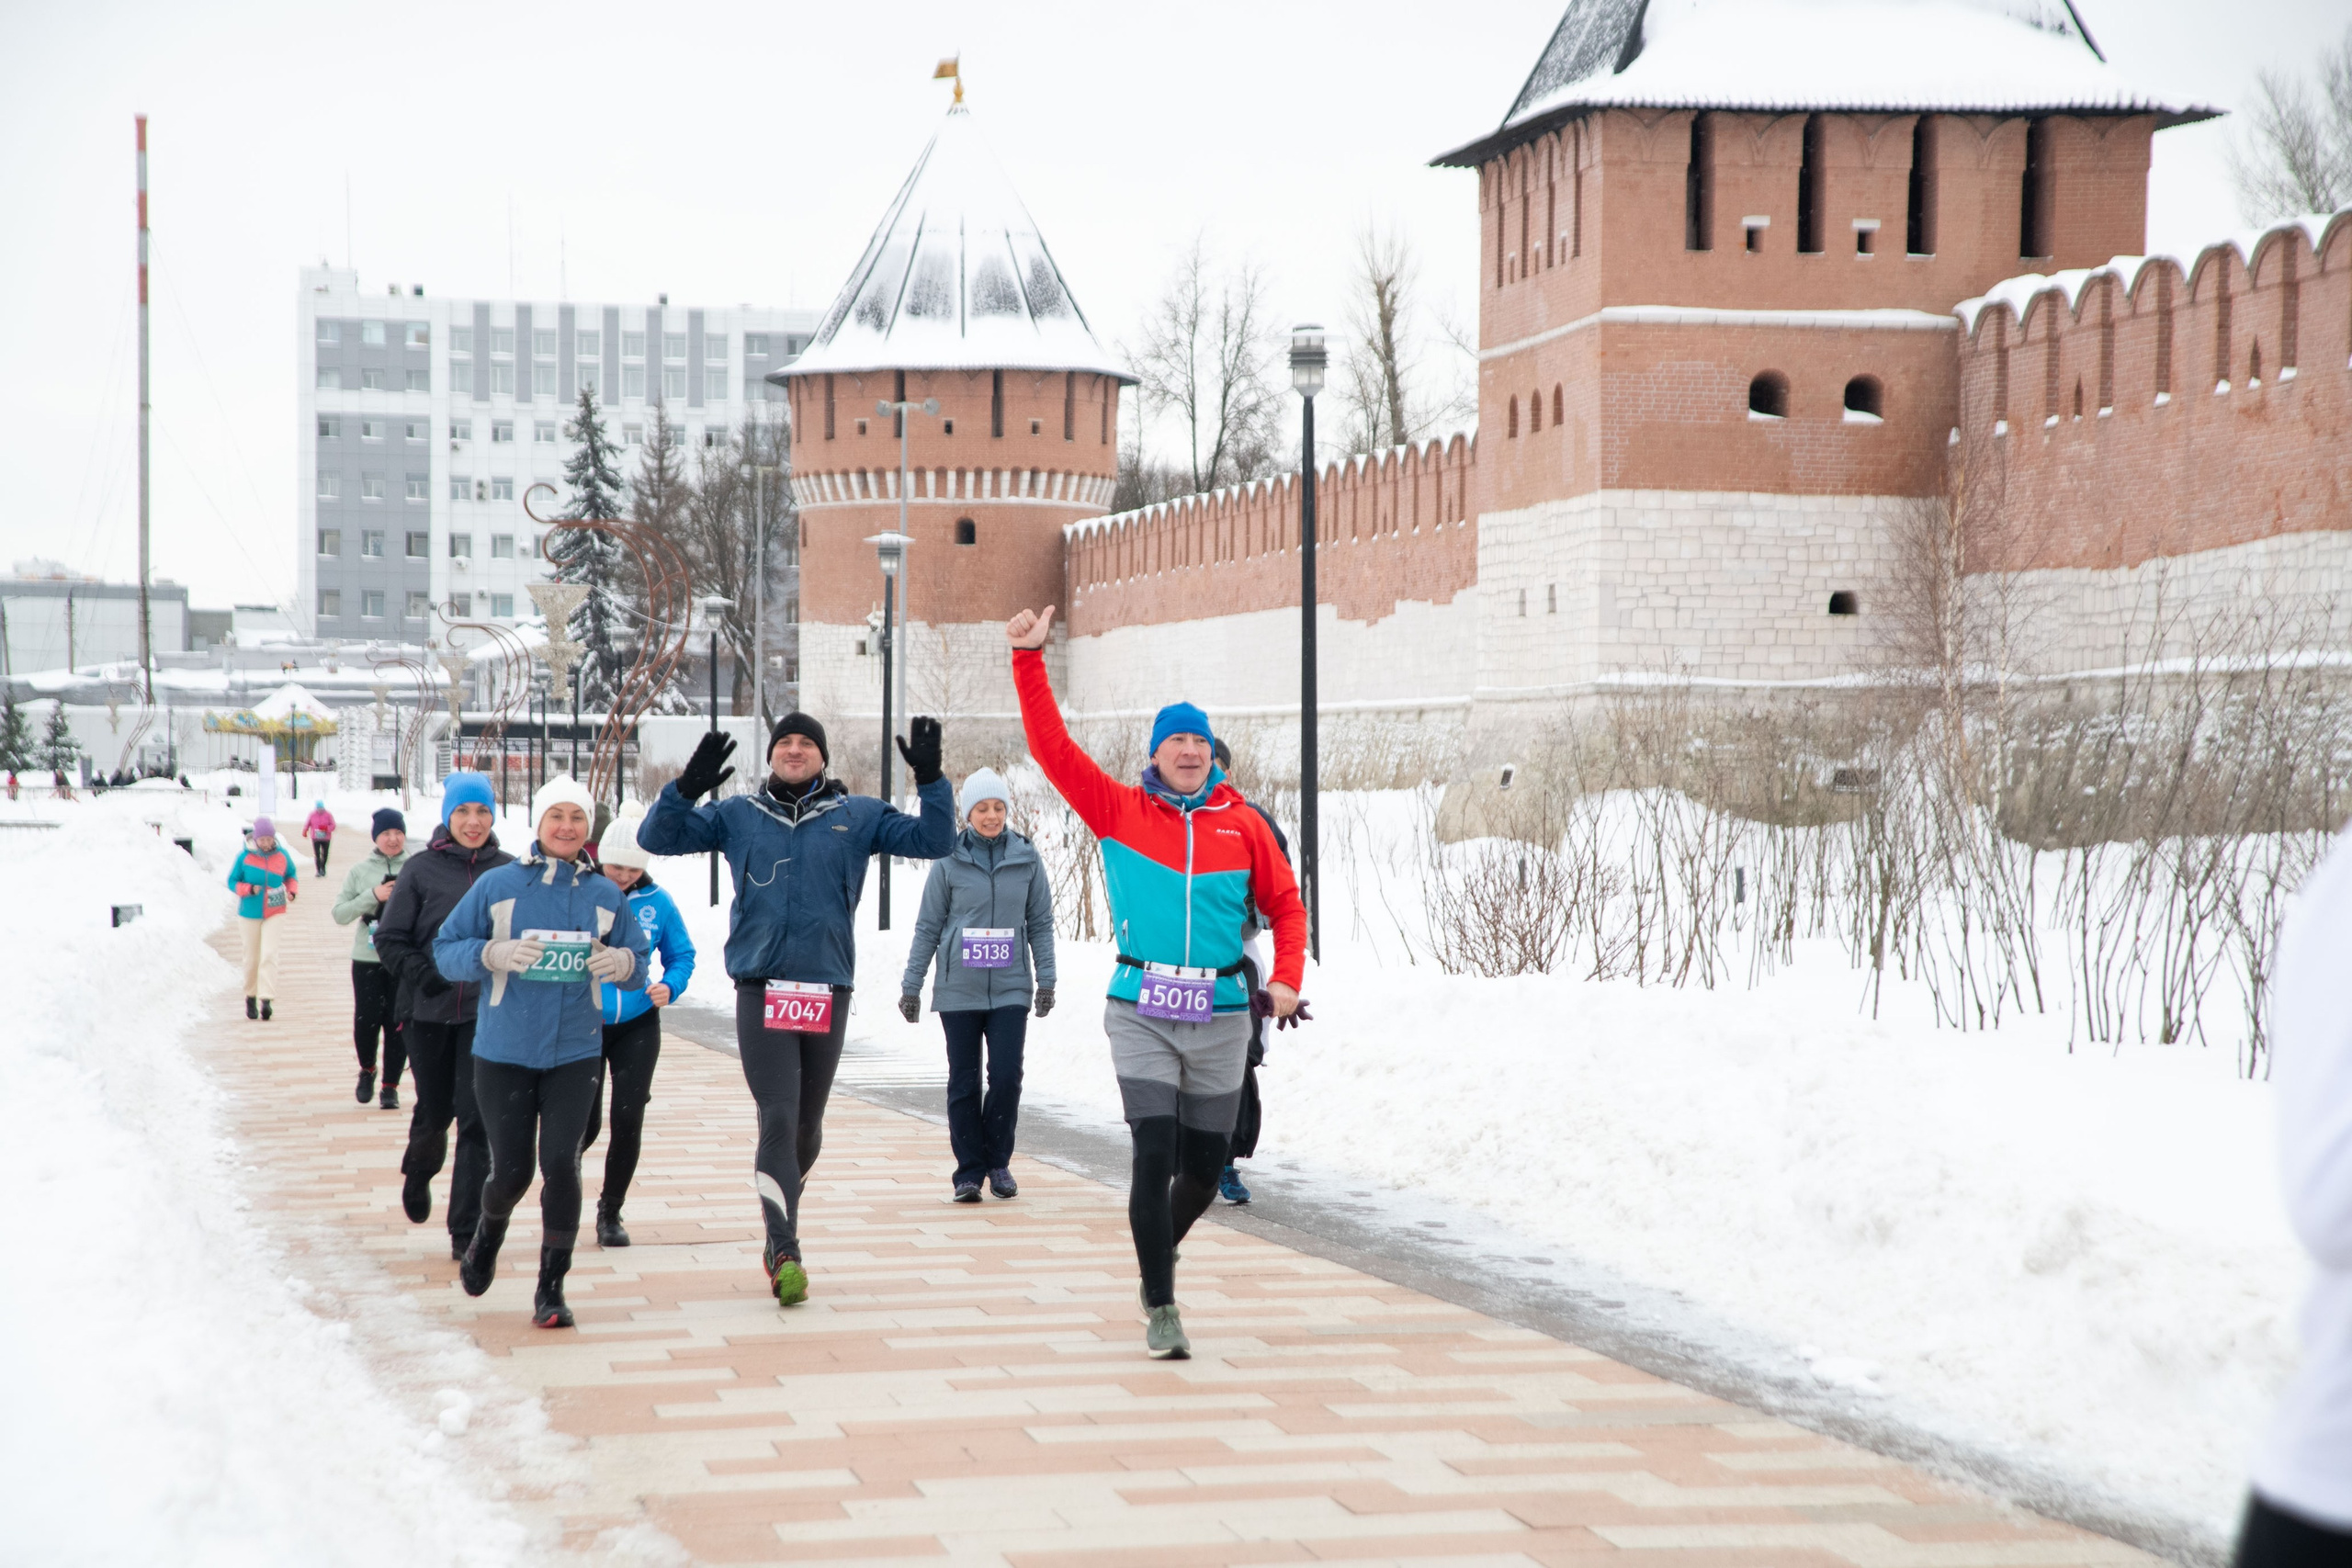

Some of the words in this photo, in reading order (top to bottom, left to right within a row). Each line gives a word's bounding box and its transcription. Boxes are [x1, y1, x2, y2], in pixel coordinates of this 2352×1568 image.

[551, 741, 589, 751] МОРОЖНОЕ
[972, 943, 1010, 960] 5138
[1151, 984, 1208, 1010] 5016
[776, 998, 826, 1021] 7047
